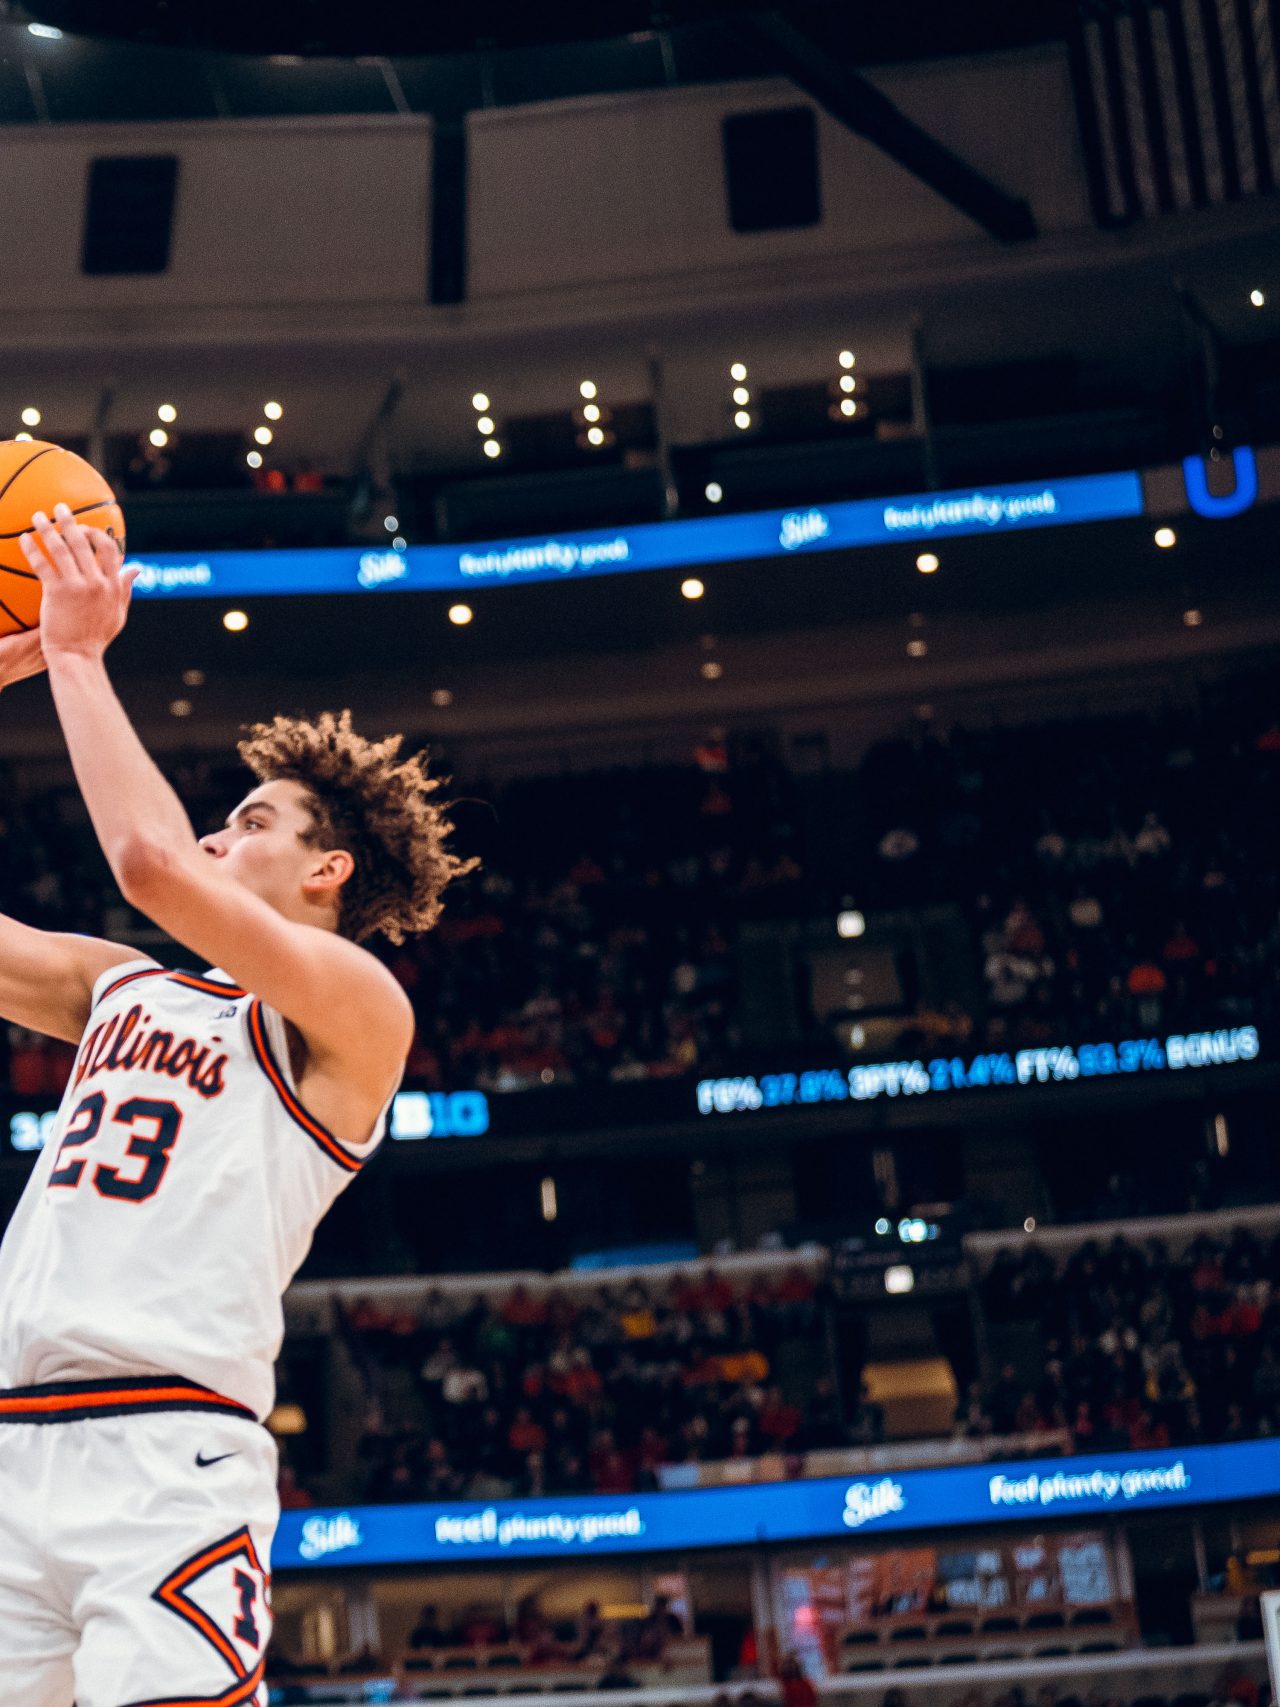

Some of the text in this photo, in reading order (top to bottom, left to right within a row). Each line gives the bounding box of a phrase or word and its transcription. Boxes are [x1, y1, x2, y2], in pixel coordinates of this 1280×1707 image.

[1166, 1025, 1260, 1070] BONUS
[47, 1090, 184, 1204] 23
[843, 1478, 908, 1527] Silk
[299, 1512, 363, 1560] Silk
